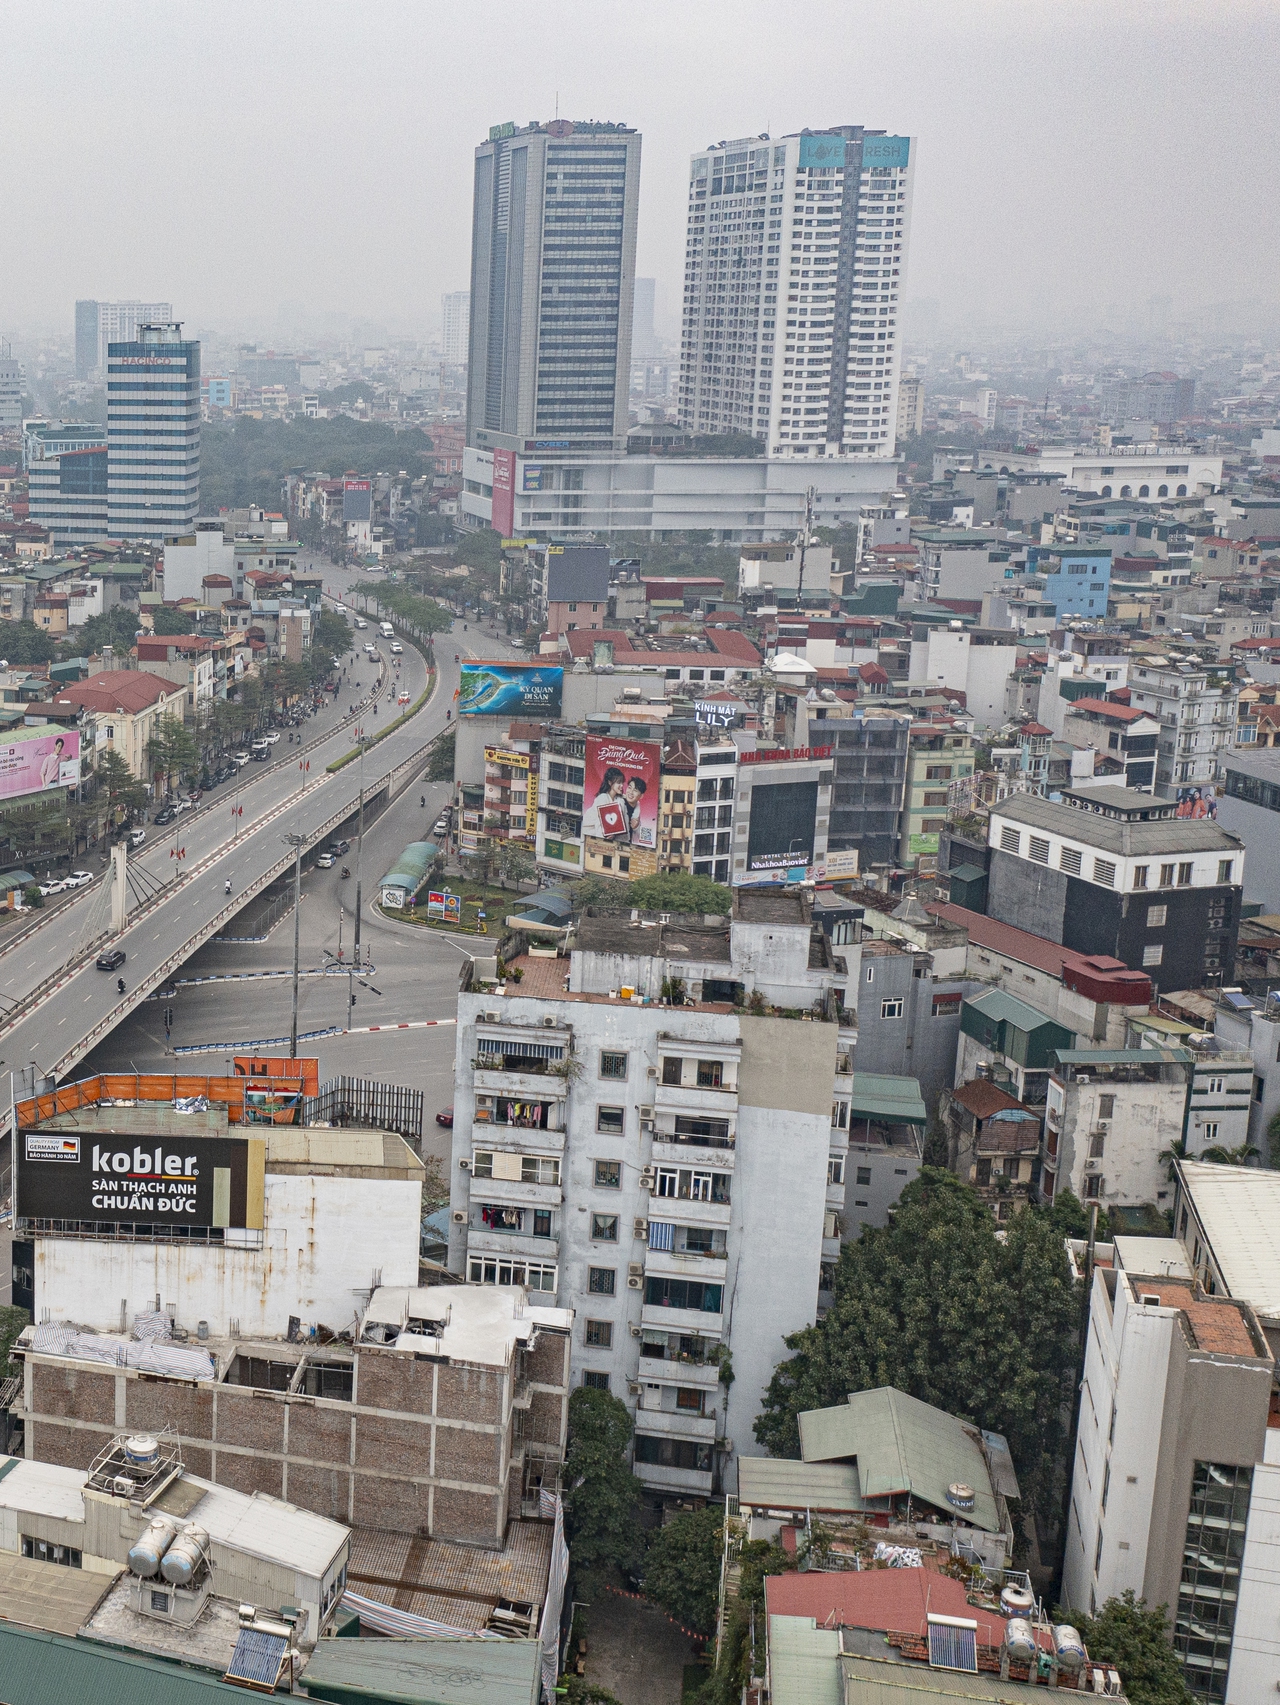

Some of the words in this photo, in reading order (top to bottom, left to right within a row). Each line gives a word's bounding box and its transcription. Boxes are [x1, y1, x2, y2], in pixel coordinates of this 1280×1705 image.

[121, 356, 172, 365] HACINCO
[695, 702, 716, 713] KÍNH
[695, 712, 734, 727] LILY
[740, 751, 762, 762] NHA
[764, 749, 791, 761] KHOA
[92, 1144, 197, 1176] kobler
[91, 1178, 119, 1191] SÀN
[120, 1181, 166, 1195] THẠCH
[168, 1183, 197, 1194] ANH
[91, 1192, 154, 1211] CHUẨN
[157, 1196, 197, 1213] ĐỨC
